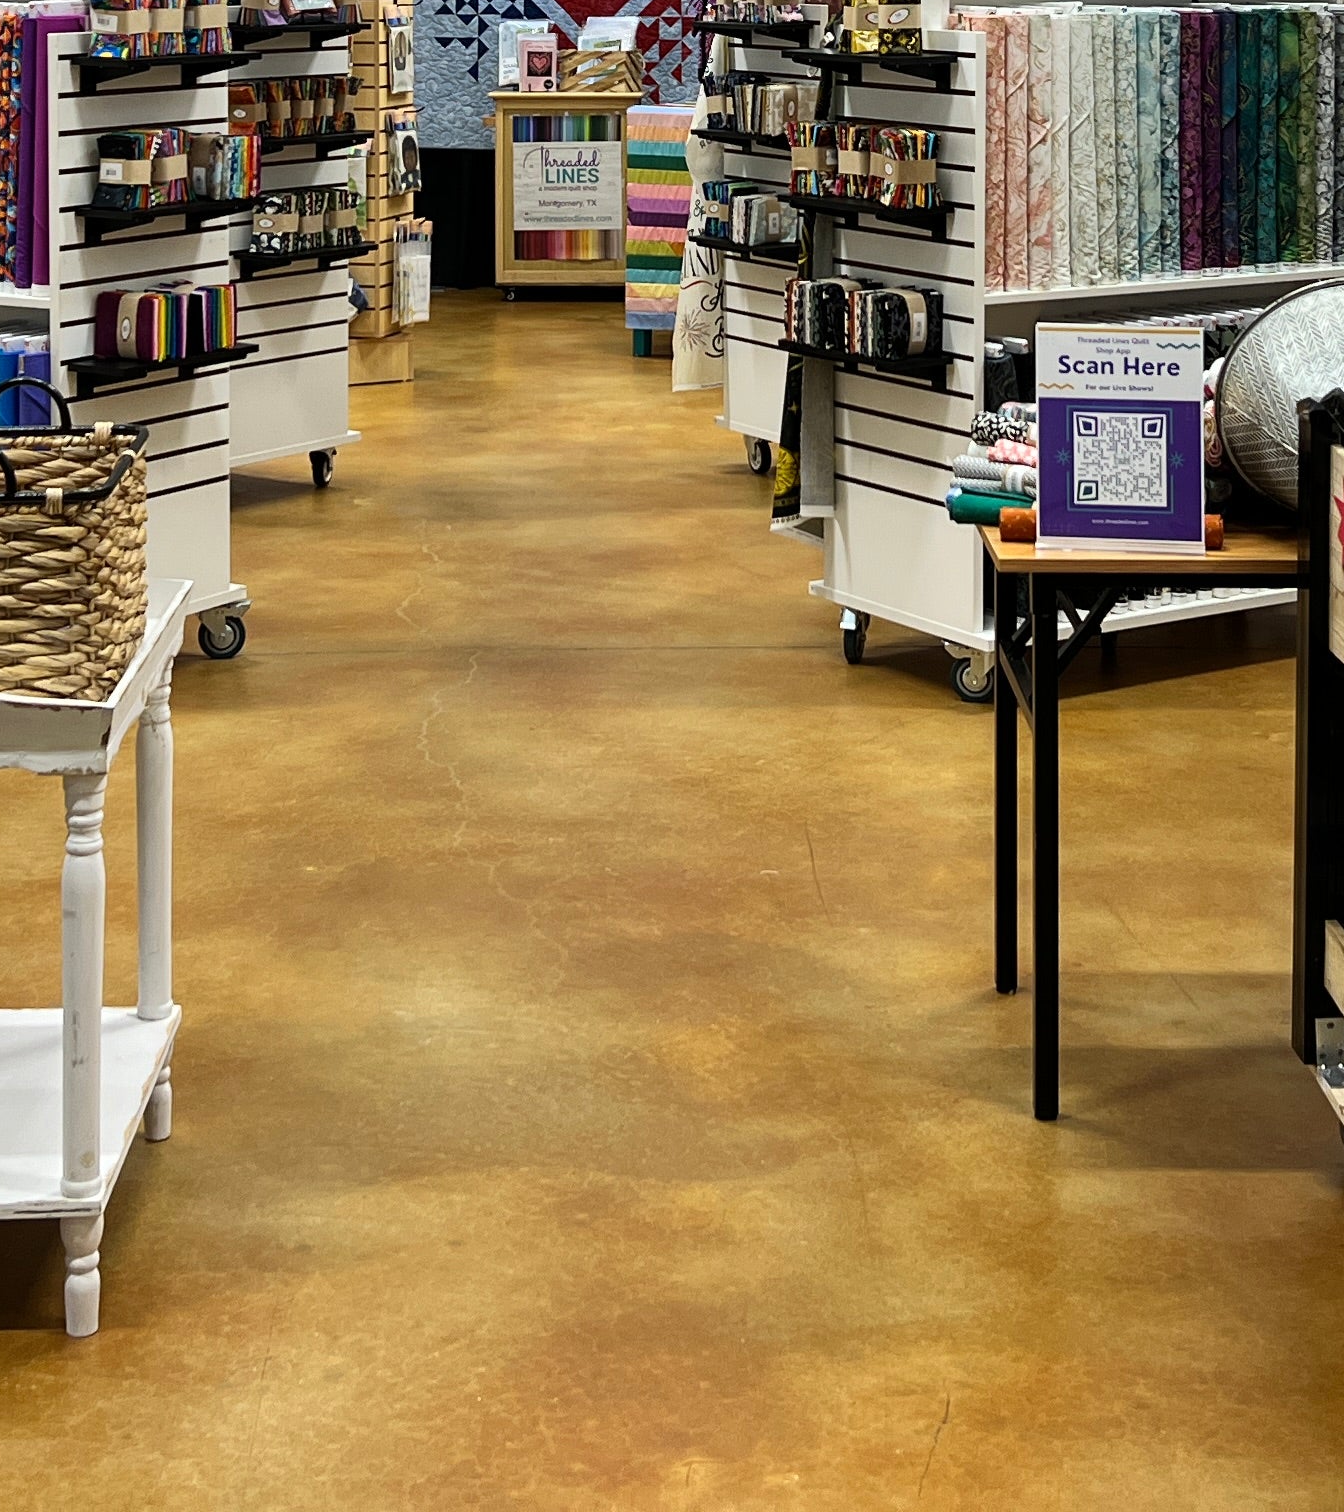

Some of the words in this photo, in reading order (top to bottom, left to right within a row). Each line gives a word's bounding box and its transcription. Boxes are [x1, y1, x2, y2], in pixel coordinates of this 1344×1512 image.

[540, 146, 601, 176] Threaded
[545, 168, 600, 184] LINES
[538, 199, 585, 209] Montgomery,
[587, 199, 598, 207] TX
[1112, 337, 1130, 345] Lines
[1096, 347, 1114, 356] Shop
[1116, 348, 1131, 356] App
[1058, 355, 1114, 375] Scan
[1123, 356, 1180, 376] Here
[1129, 384, 1154, 392] Shows!
